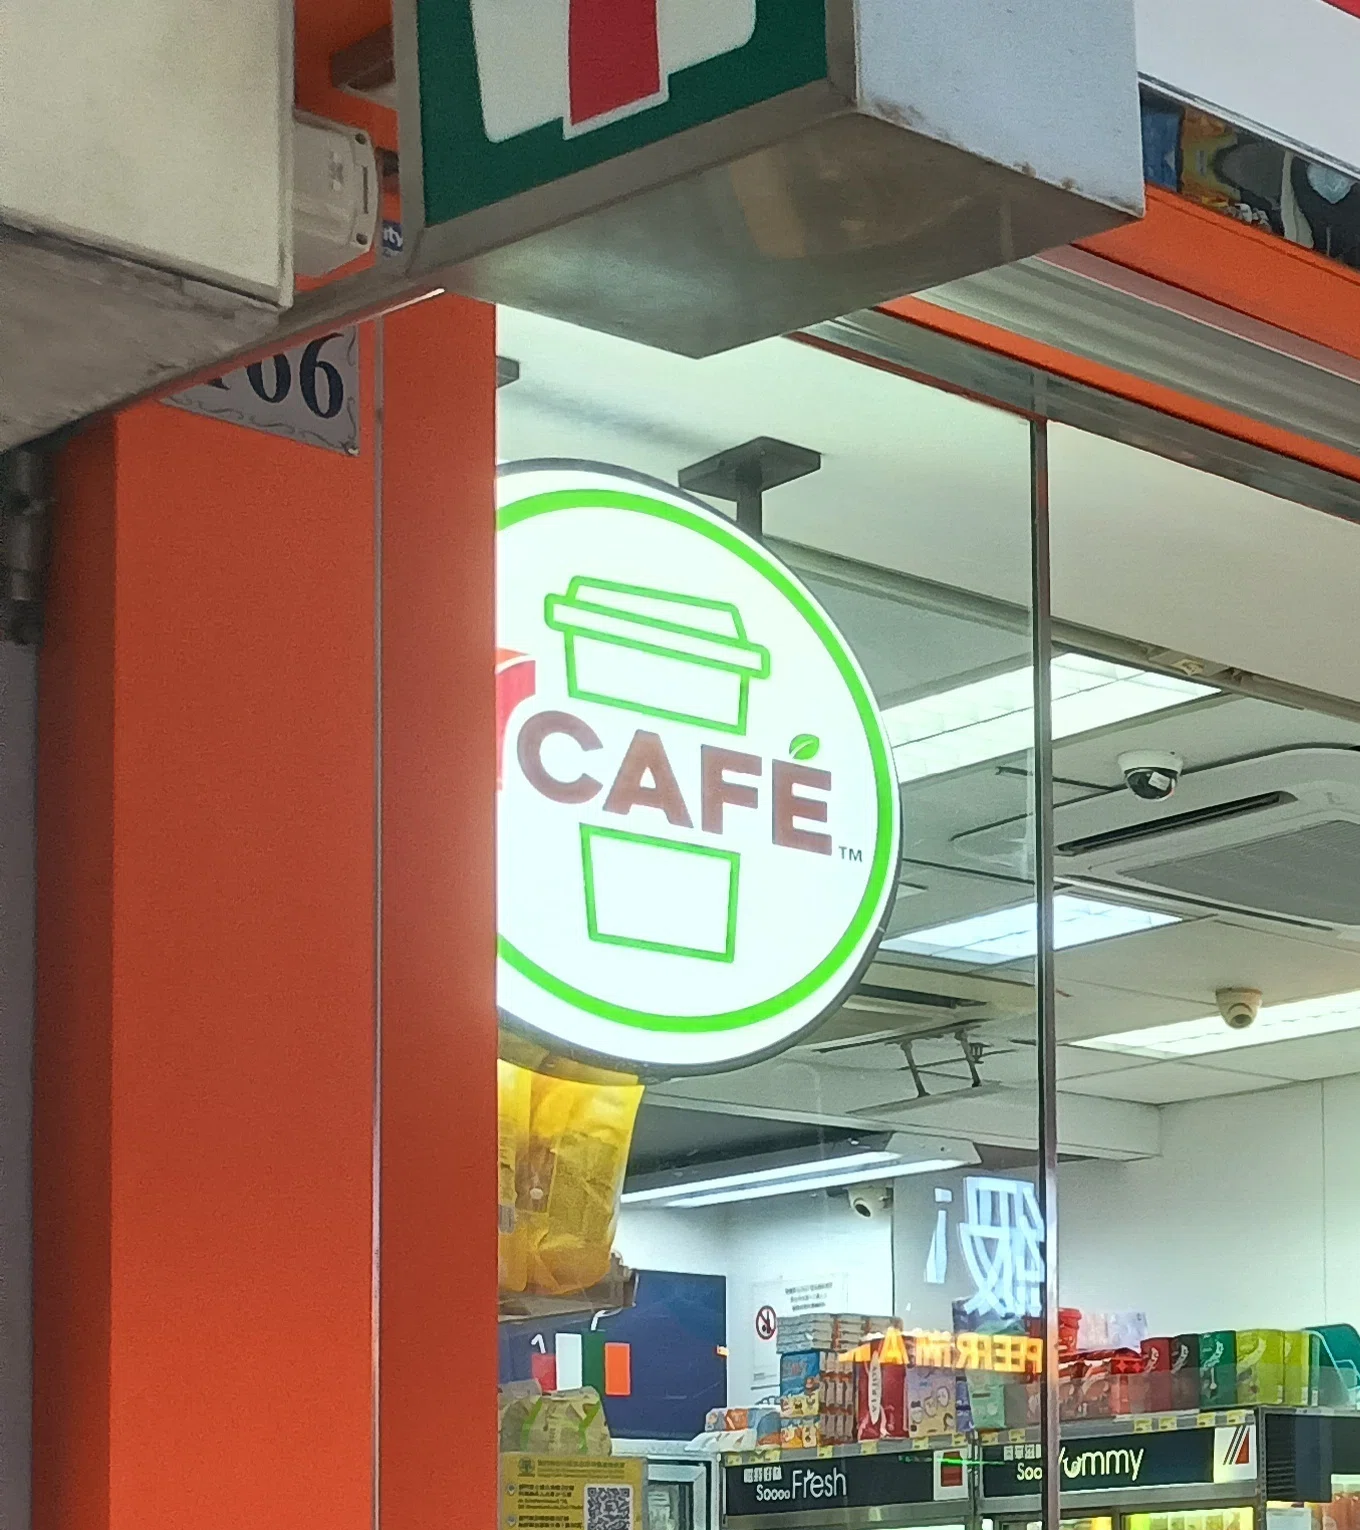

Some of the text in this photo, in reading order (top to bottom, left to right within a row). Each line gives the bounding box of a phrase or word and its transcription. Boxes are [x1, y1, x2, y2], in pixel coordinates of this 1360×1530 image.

[205, 328, 346, 420] 06
[516, 709, 832, 856] CAFÉ
[792, 1467, 847, 1501] Fresh
